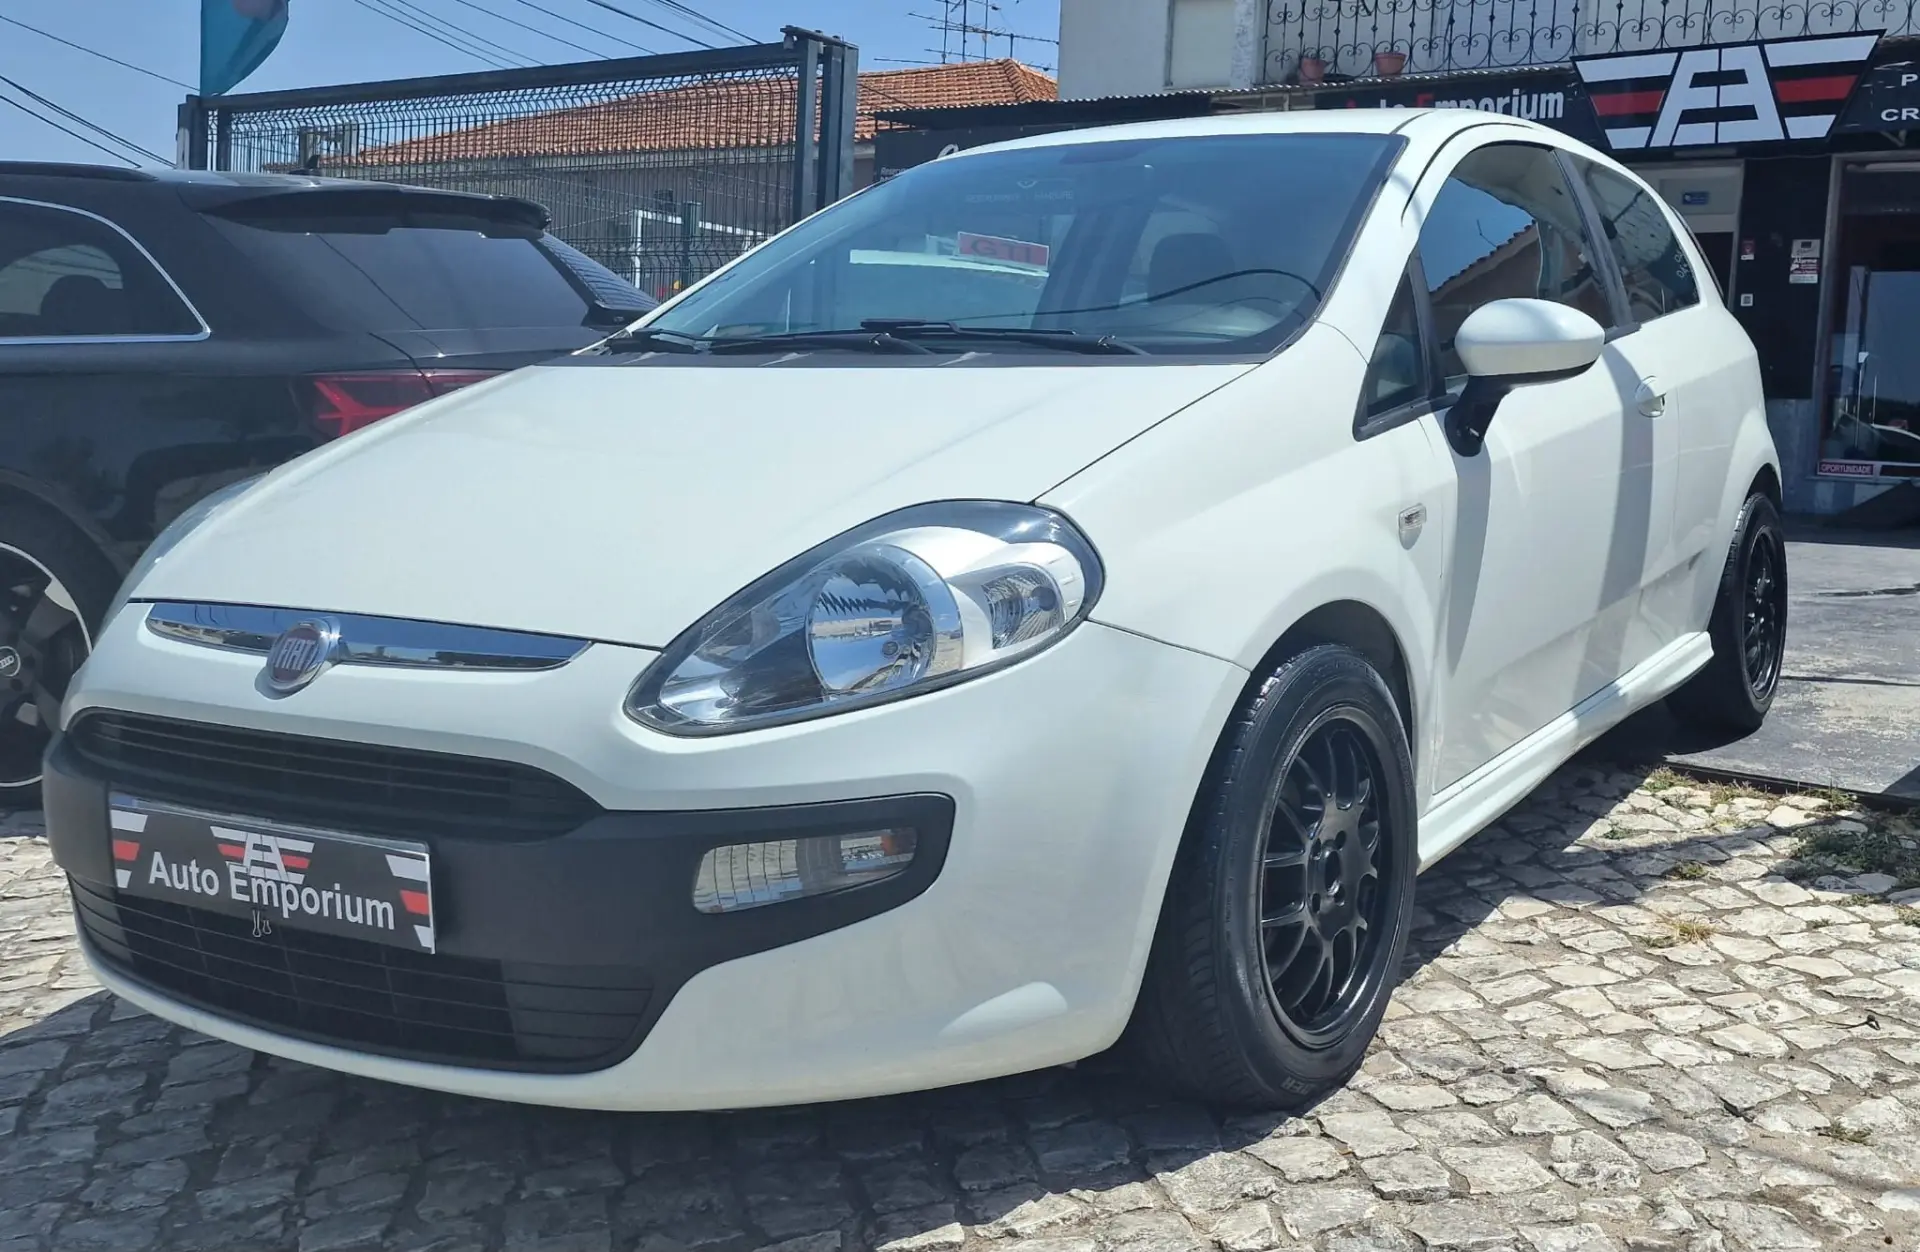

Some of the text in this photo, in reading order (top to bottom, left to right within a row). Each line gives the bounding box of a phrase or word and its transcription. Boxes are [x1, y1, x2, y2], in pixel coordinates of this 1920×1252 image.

[274, 637, 317, 671] FIAT
[149, 851, 395, 930] Auto Emporium
